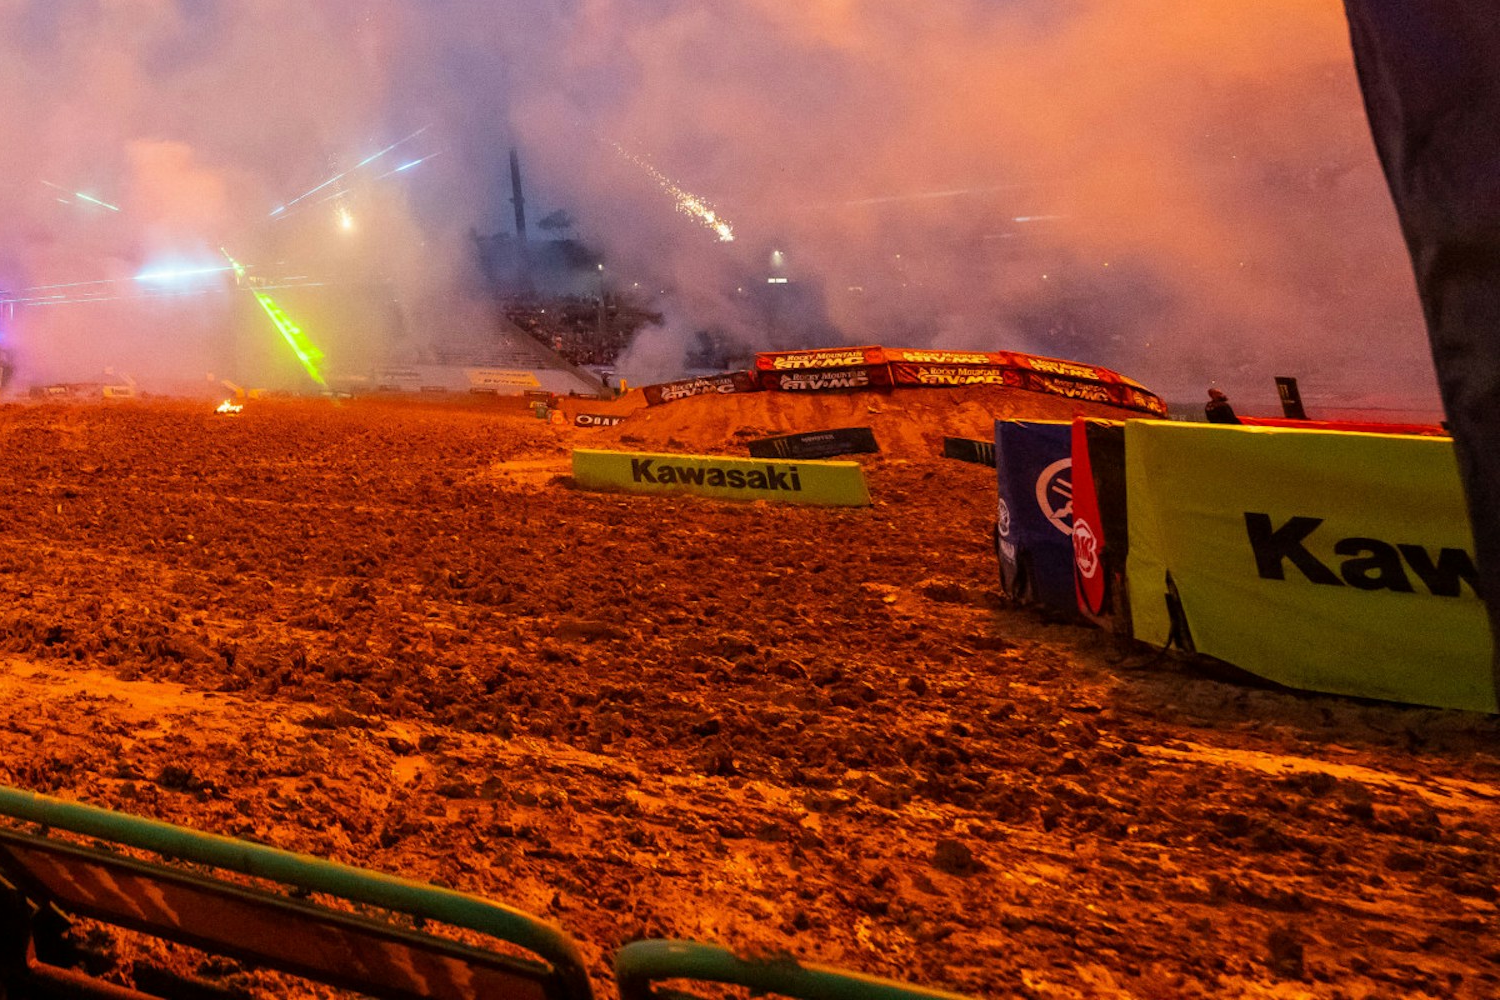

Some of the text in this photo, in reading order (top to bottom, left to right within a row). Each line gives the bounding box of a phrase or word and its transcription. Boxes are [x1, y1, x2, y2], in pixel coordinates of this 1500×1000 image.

[816, 351, 863, 359] MOUNTAIN
[821, 370, 867, 380] MOUNTAIN
[631, 458, 802, 491] Kawasaki
